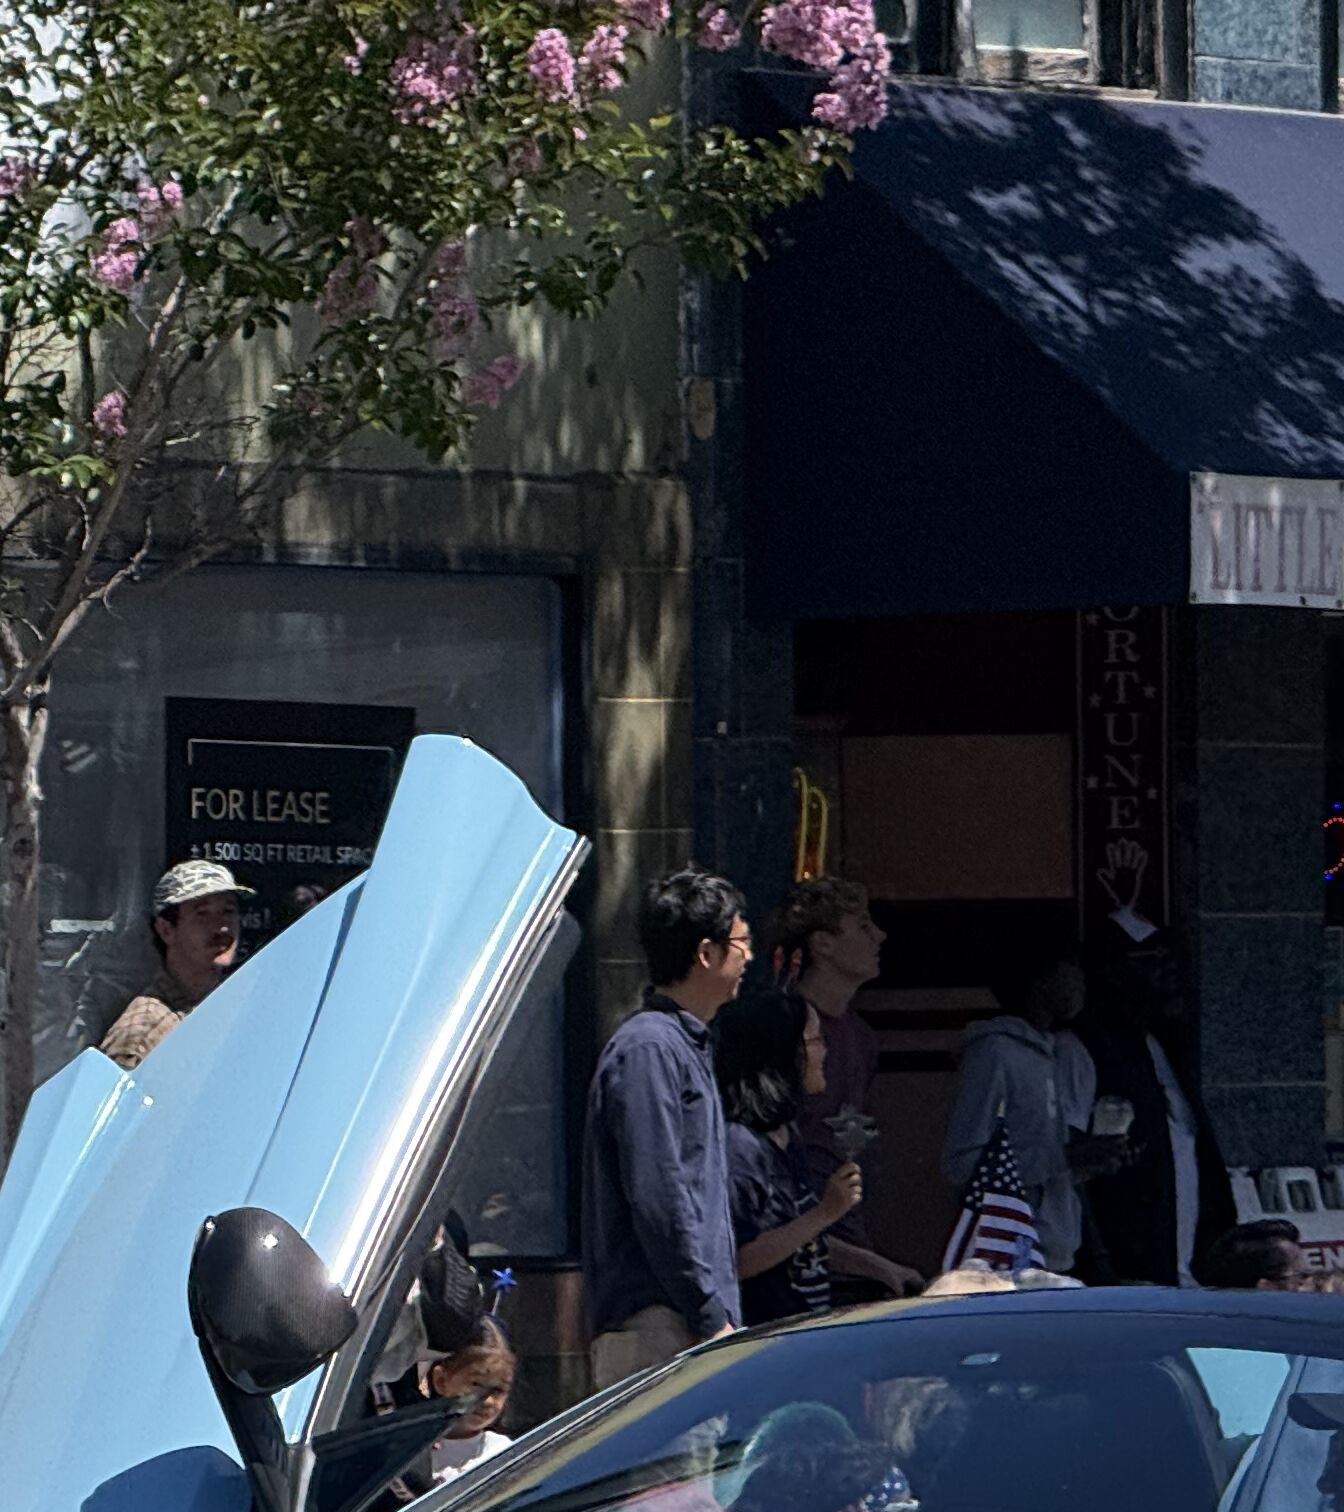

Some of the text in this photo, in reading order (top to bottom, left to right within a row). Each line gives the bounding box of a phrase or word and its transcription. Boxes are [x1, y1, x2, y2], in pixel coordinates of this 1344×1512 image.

[191, 787, 331, 824] FOR LEASE
[242, 843, 265, 865] SQ
[267, 844, 285, 862] FT
[287, 844, 333, 864] RETAIL
[336, 846, 373, 866] SPAC
